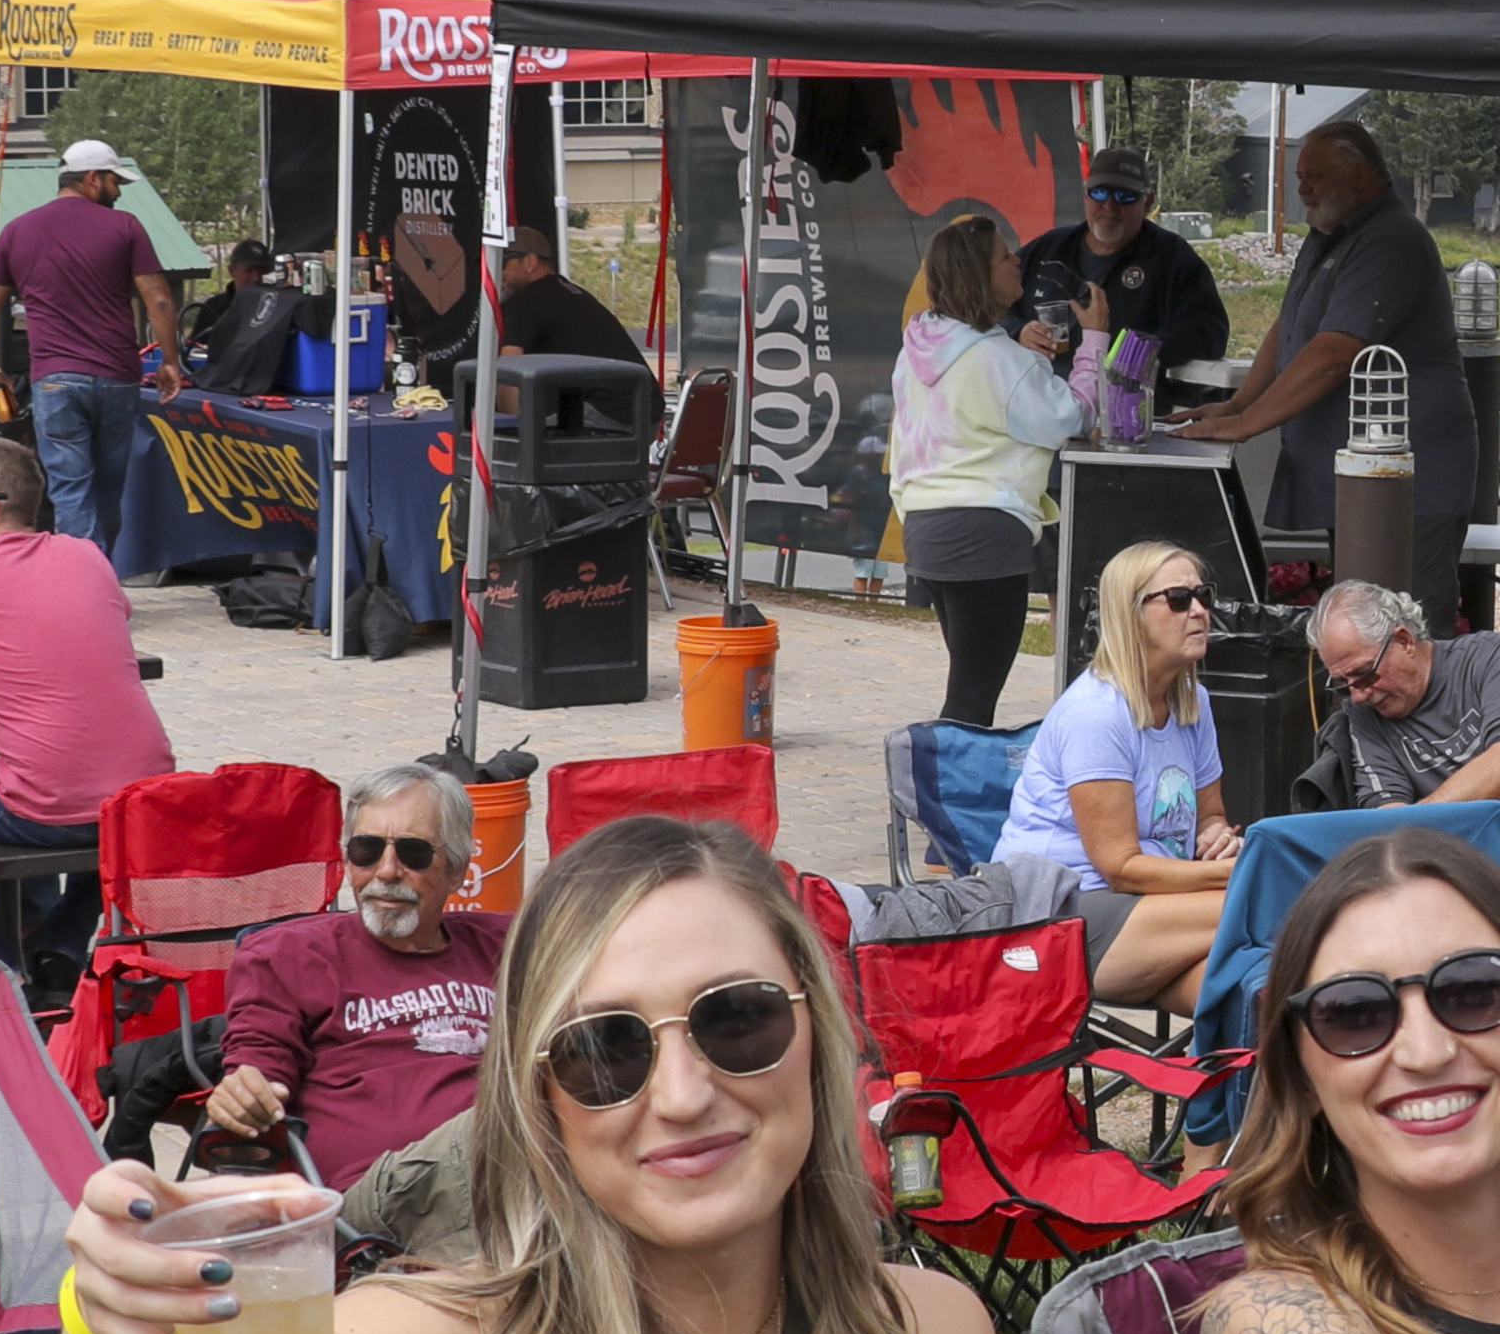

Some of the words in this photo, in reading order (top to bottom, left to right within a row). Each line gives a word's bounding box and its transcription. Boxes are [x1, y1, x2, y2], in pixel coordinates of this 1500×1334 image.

[93, 30, 124, 46] GREAT
[129, 32, 154, 48] BEER
[168, 34, 205, 52] GRITTY
[210, 37, 240, 54] TOWN
[254, 40, 283, 59] GOOD
[288, 42, 329, 63] PEOPLE
[517, 63, 540, 74] CO.
[394, 152, 460, 182] DENTED
[401, 188, 457, 216] BRICK
[405, 220, 455, 236] DISTILLERY
[805, 220, 832, 362] BREWING
[147, 414, 320, 529] ROOSTERS
[344, 984, 448, 1031] CARLSBAD
[447, 981, 497, 1016] CAVE
